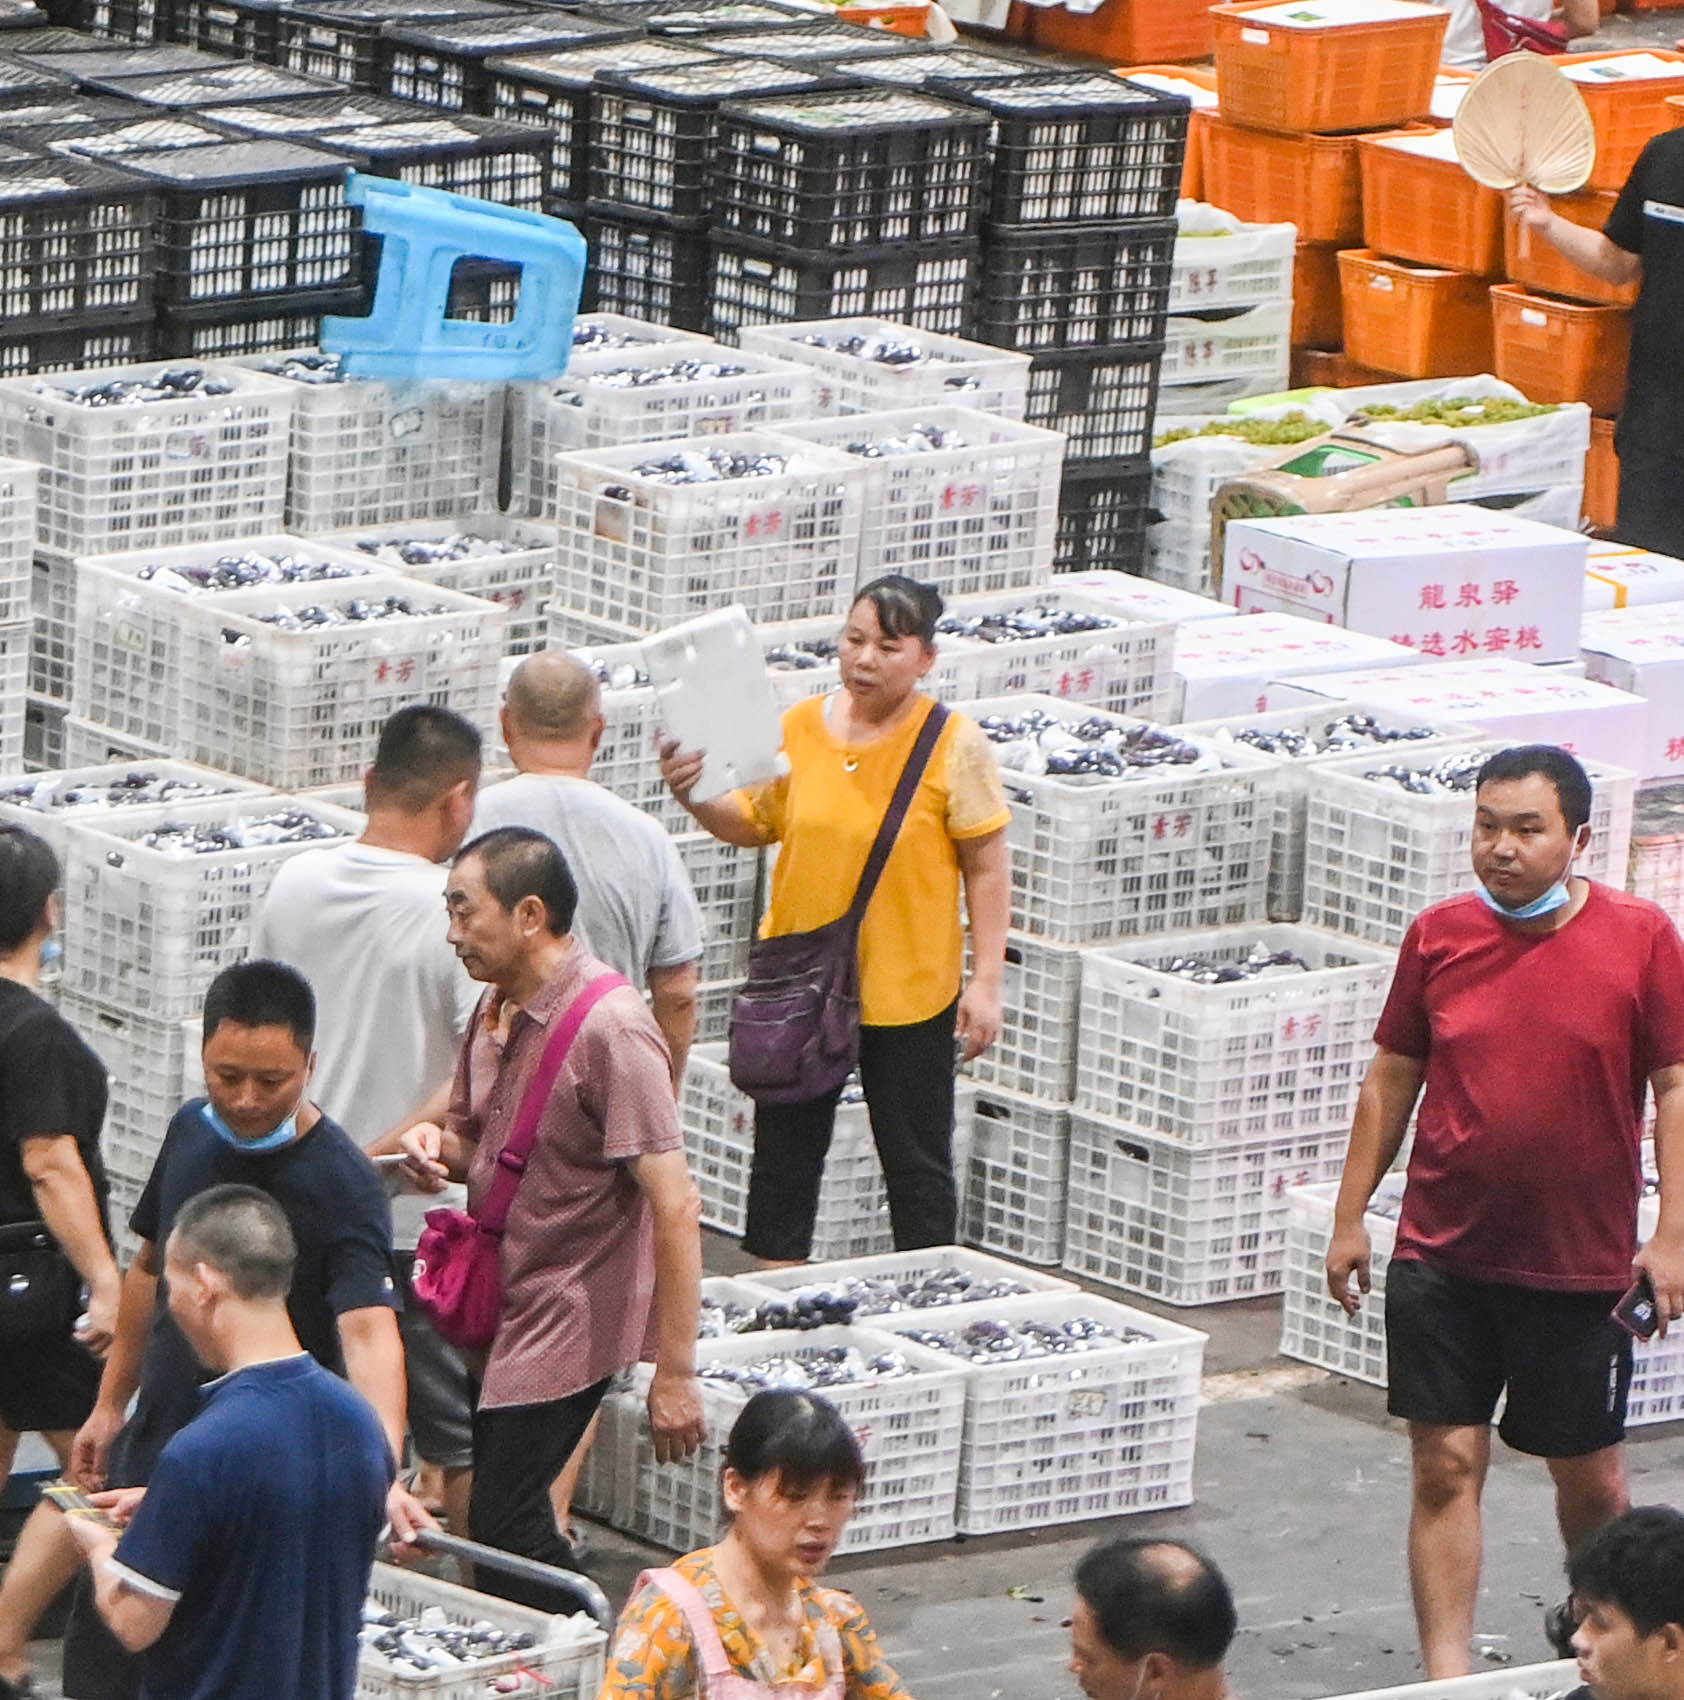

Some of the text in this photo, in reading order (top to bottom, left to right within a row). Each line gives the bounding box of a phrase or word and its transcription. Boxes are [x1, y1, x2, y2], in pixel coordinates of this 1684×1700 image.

[940, 484, 980, 510] 素芳
[375, 659, 414, 685] 素芳
[1058, 667, 1095, 696] 素芳
[1151, 812, 1192, 841] 素芳
[1281, 1013, 1322, 1041] 素芳
